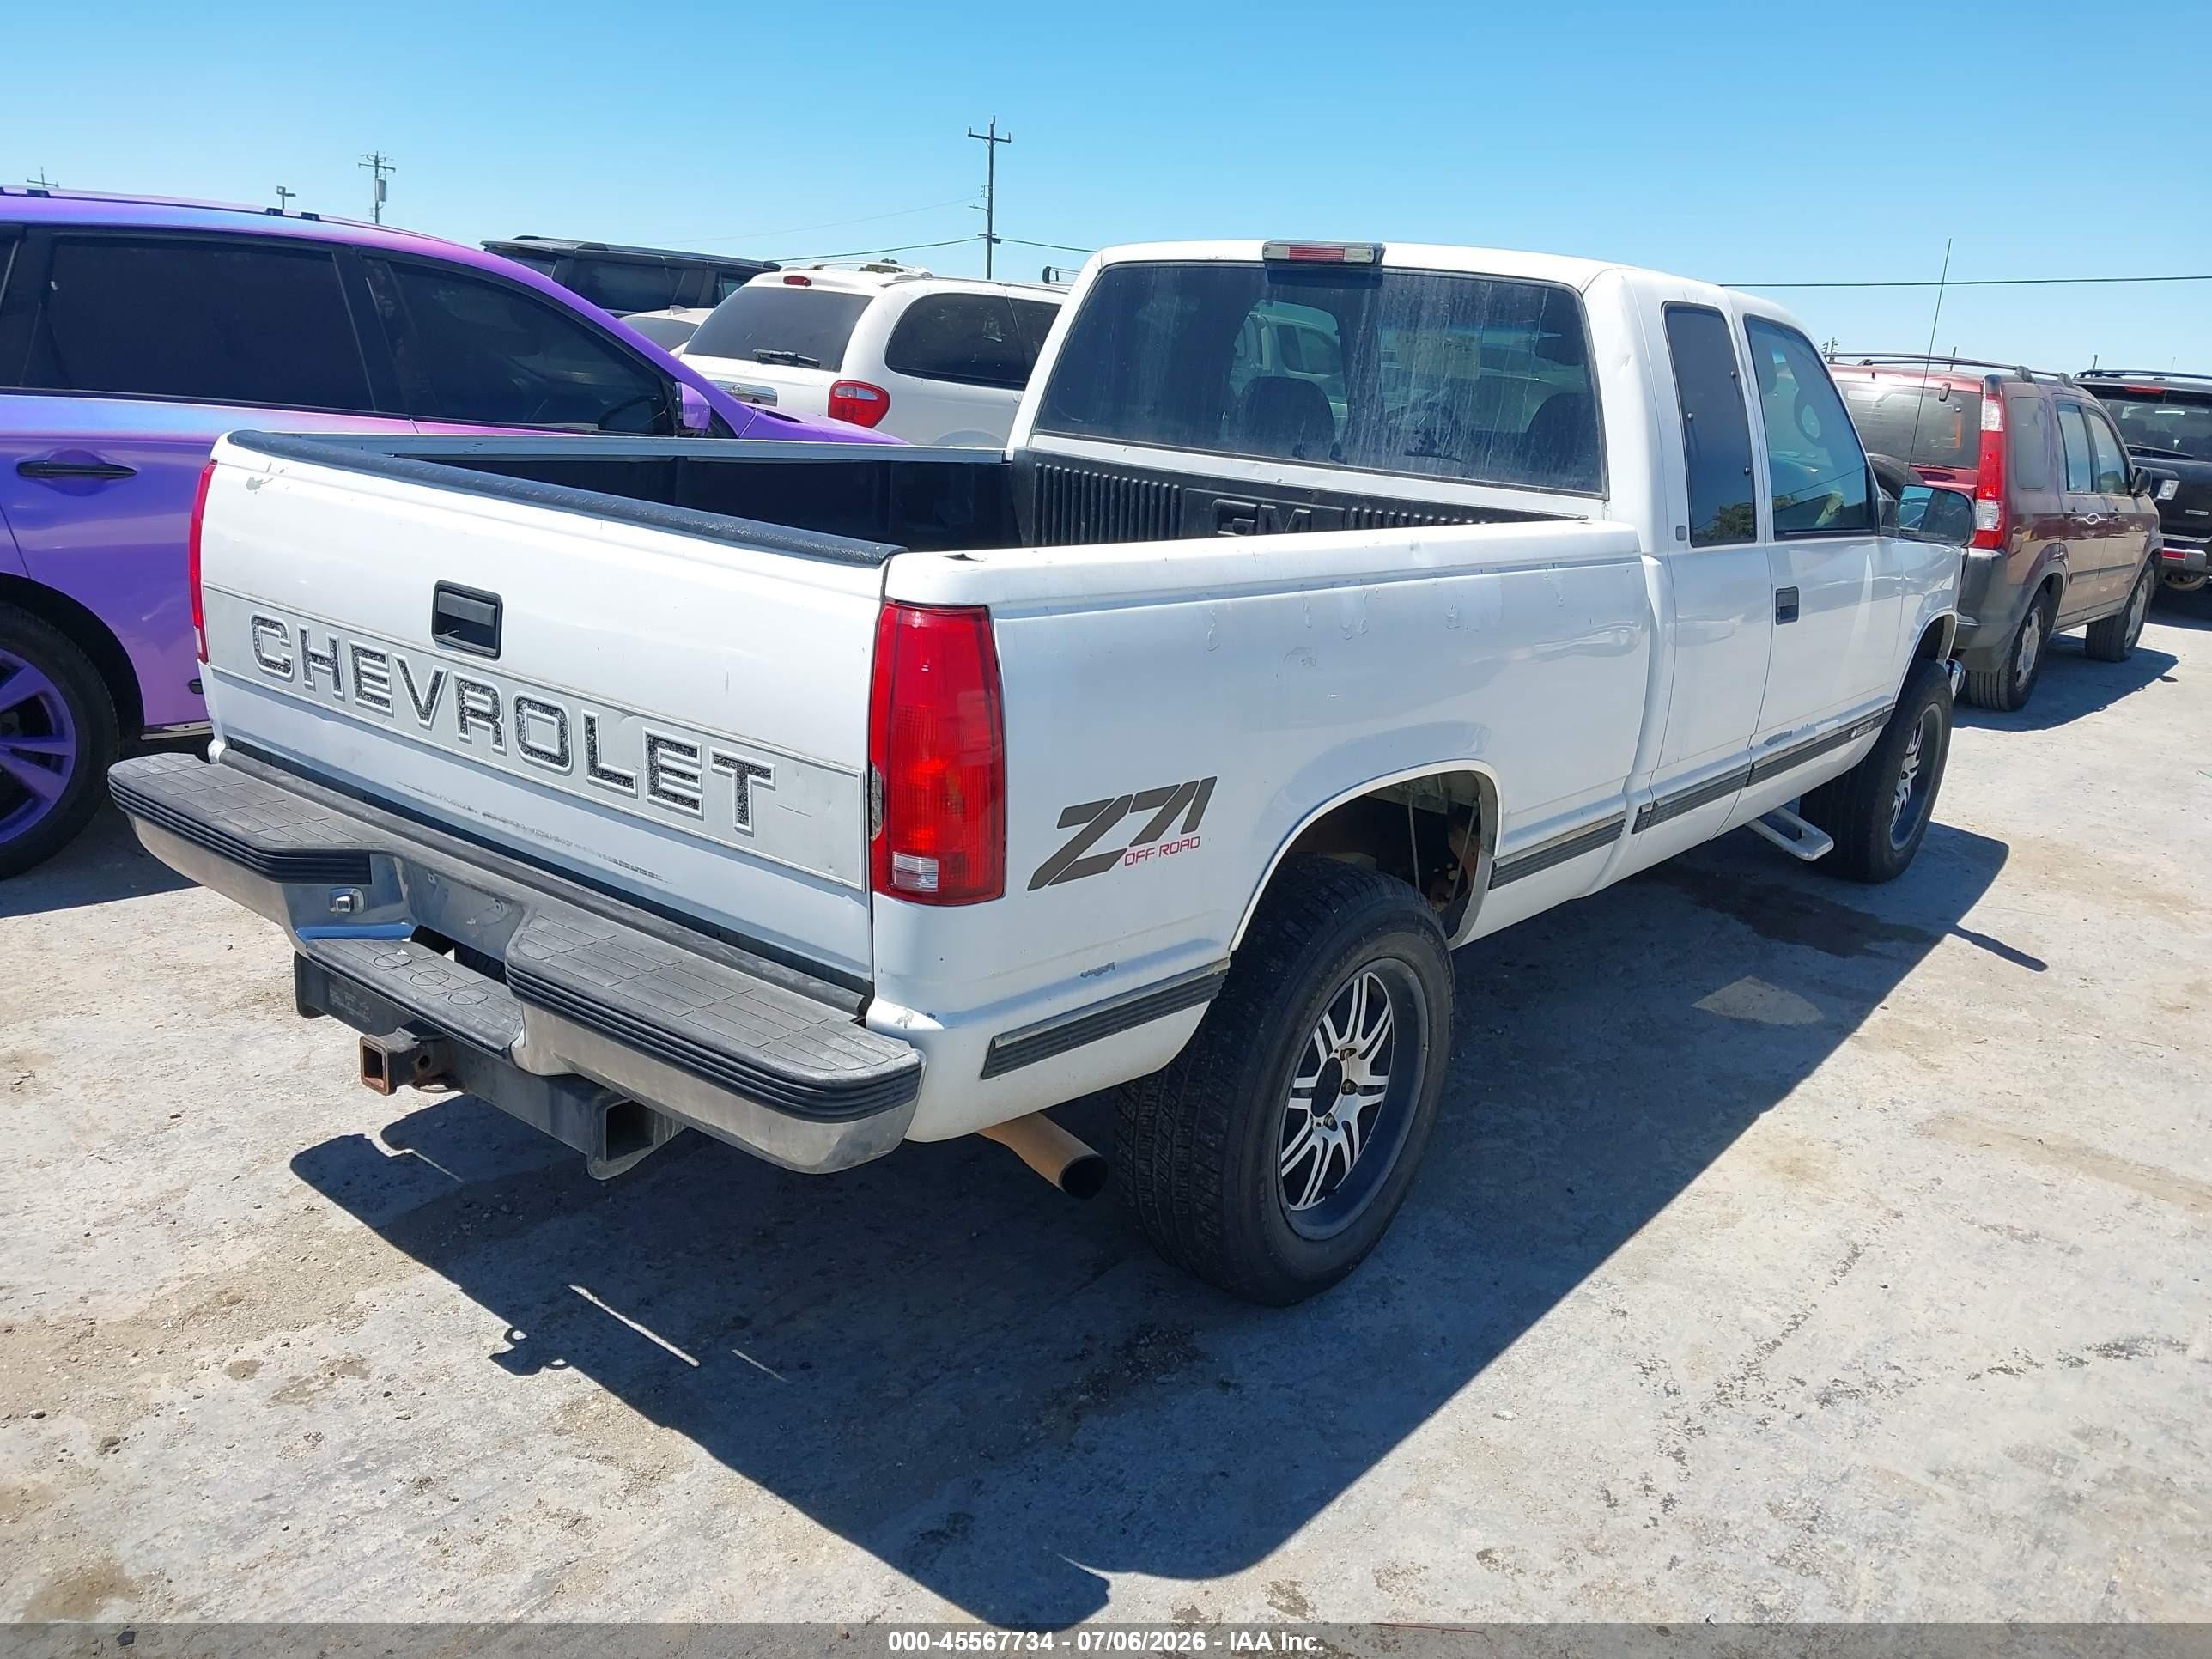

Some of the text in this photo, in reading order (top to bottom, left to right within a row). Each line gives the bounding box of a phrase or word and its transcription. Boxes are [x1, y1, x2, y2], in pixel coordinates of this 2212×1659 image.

[250, 613, 775, 836] CHEVROLET
[1027, 776, 1217, 891] Z71
[1124, 836, 1201, 866] OFF ROAD
